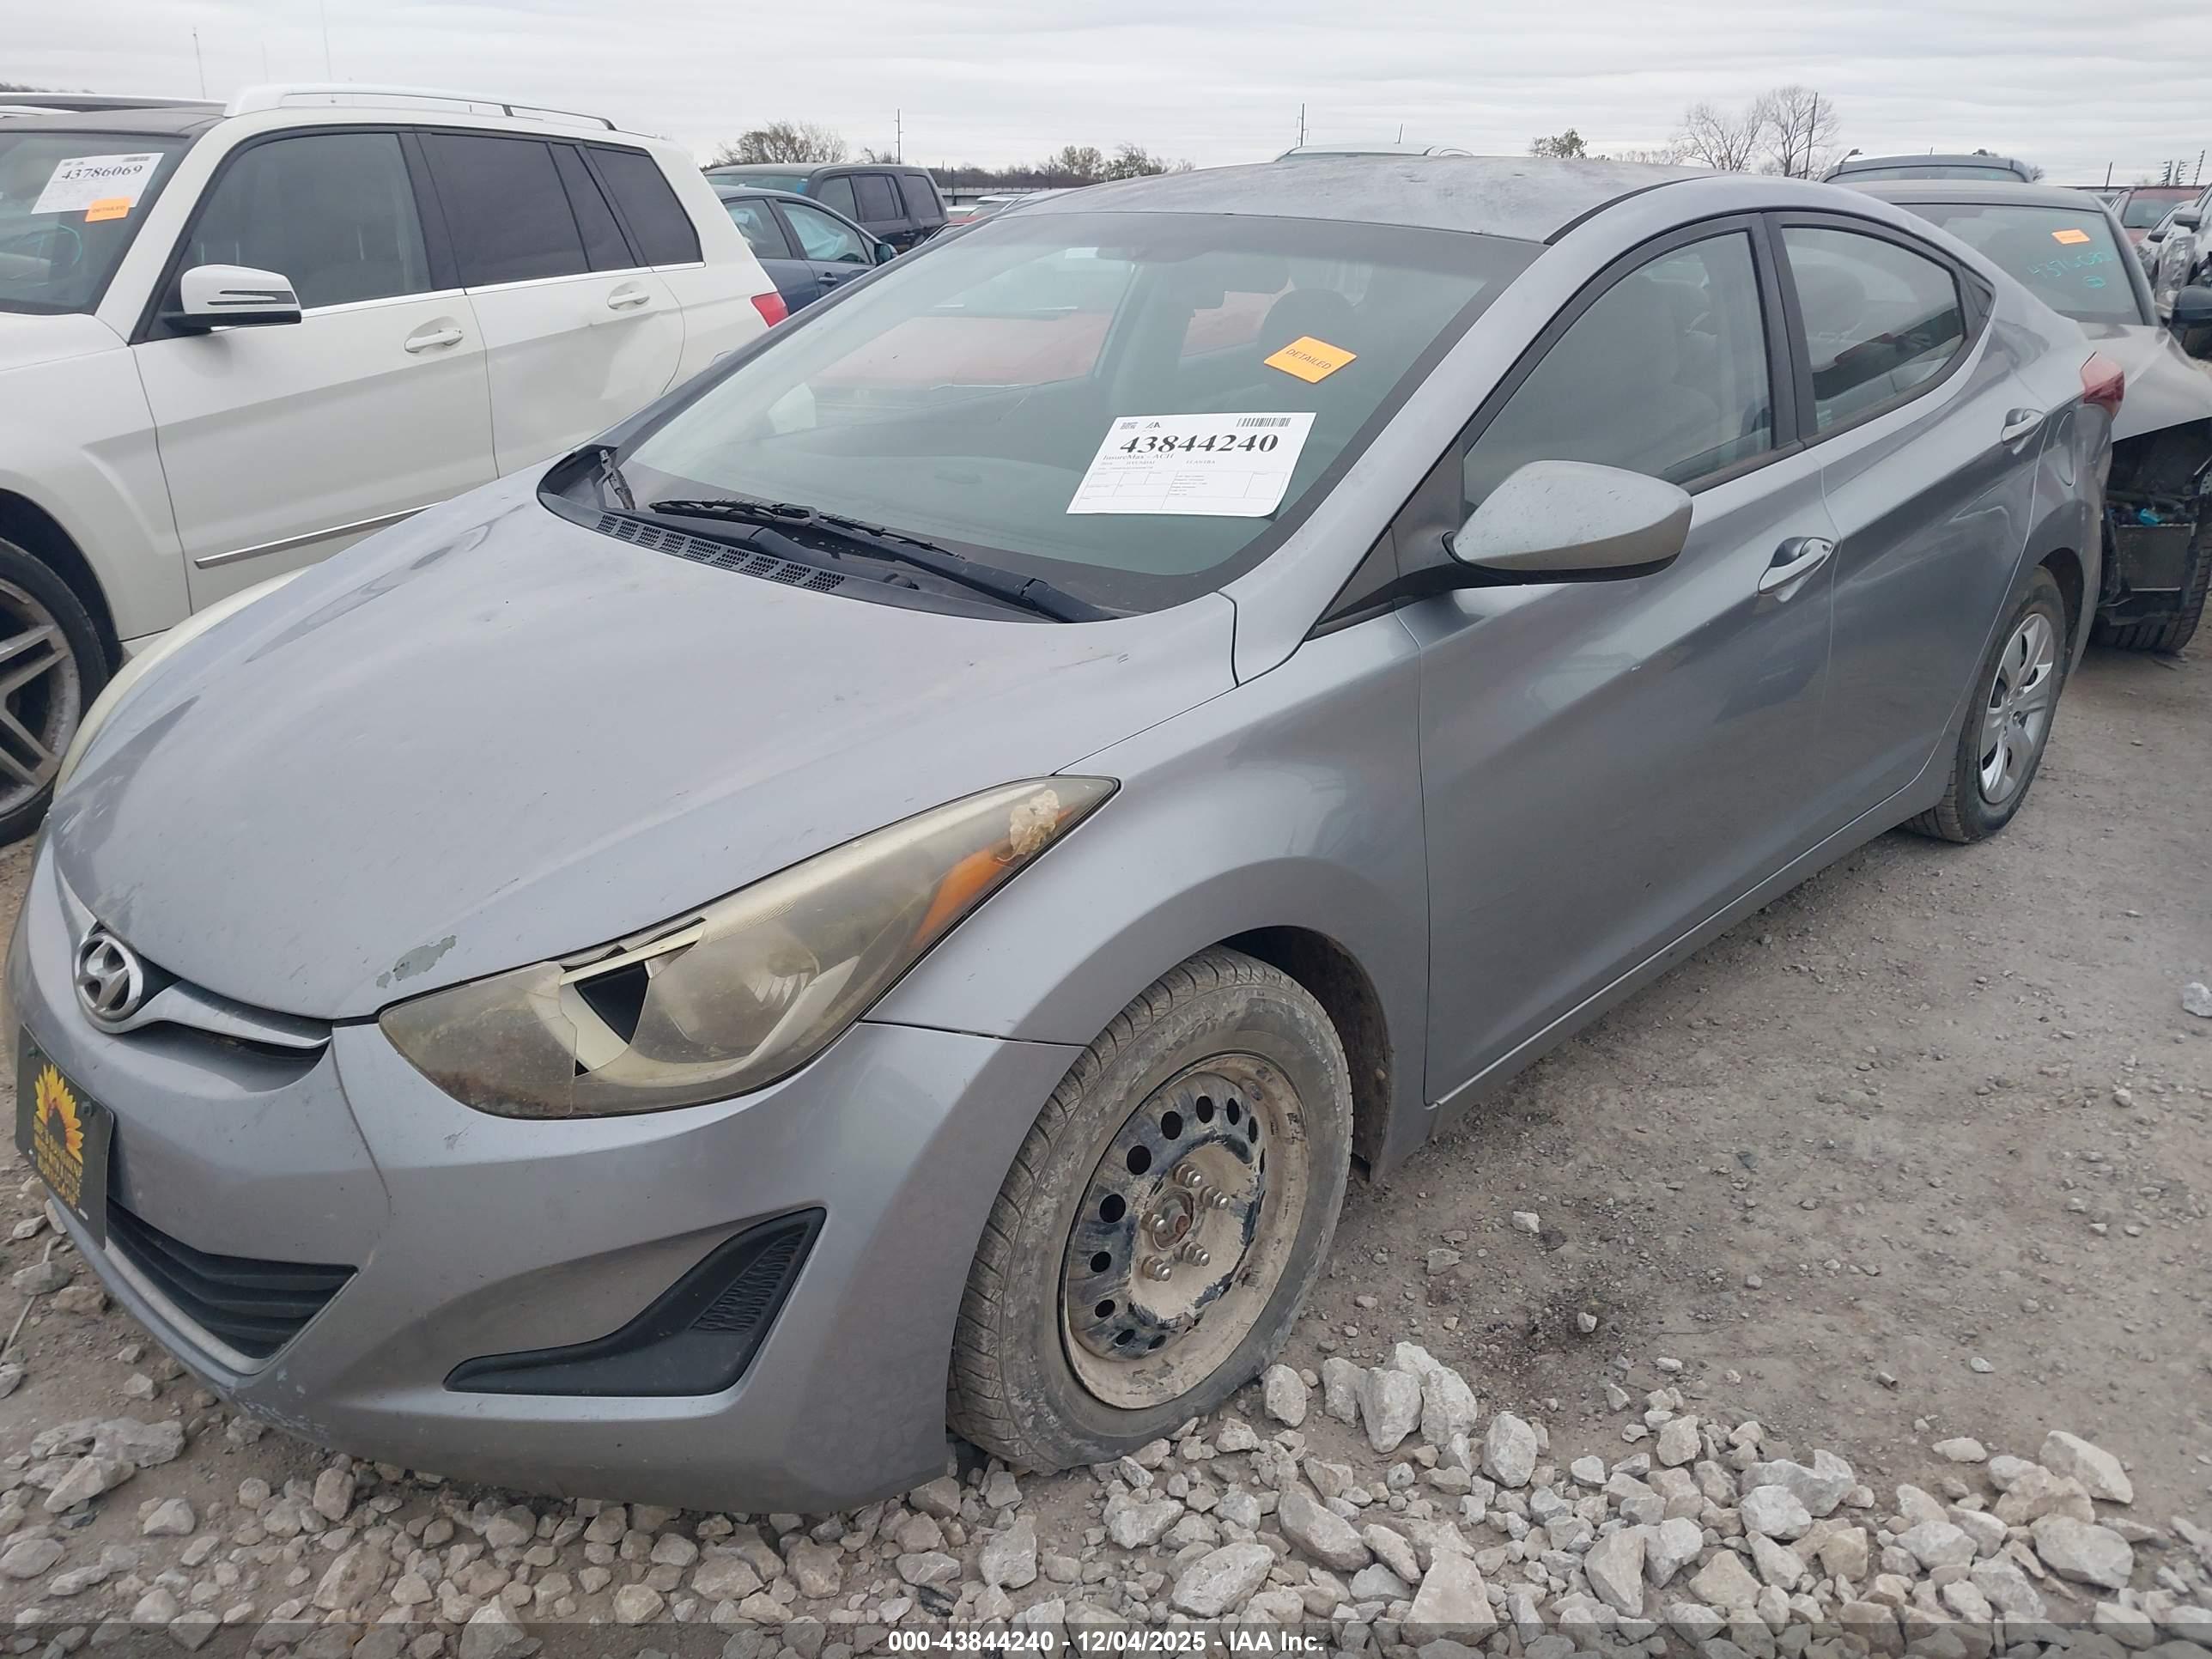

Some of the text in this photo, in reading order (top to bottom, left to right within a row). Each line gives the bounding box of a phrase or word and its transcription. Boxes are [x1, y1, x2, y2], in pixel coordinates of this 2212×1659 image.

[62, 164, 143, 179] 43786069
[1285, 348, 1332, 369] DETAILED
[1119, 434, 1279, 453] 43844240
